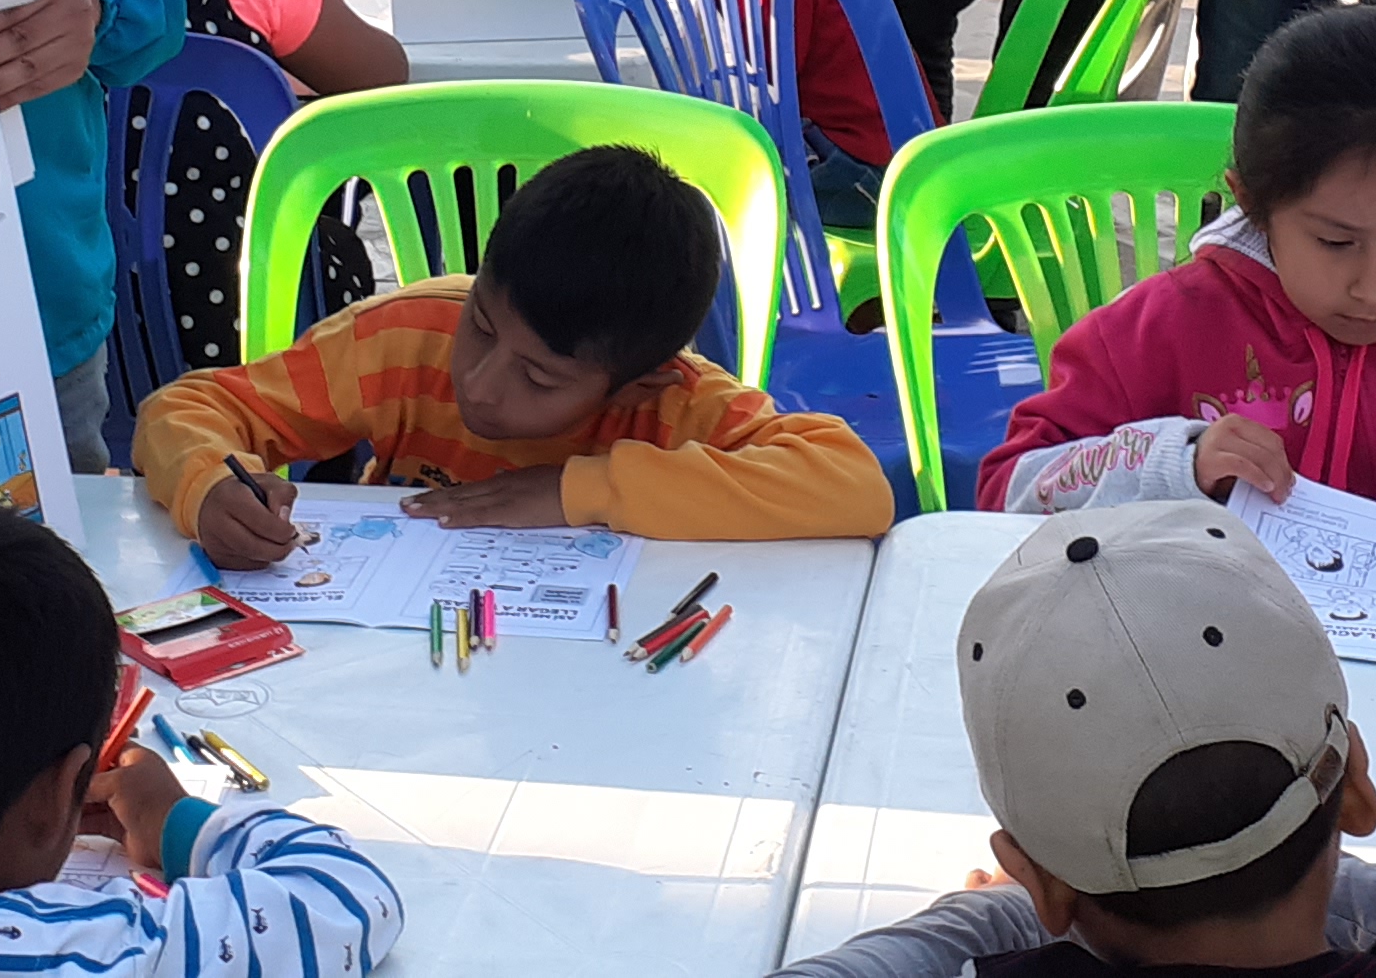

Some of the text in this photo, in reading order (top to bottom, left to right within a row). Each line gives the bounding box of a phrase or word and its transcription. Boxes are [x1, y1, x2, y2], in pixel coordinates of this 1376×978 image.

[274, 595, 323, 603] AGUA
[516, 605, 579, 616] LLEGAR
[1325, 629, 1364, 638] AGU
